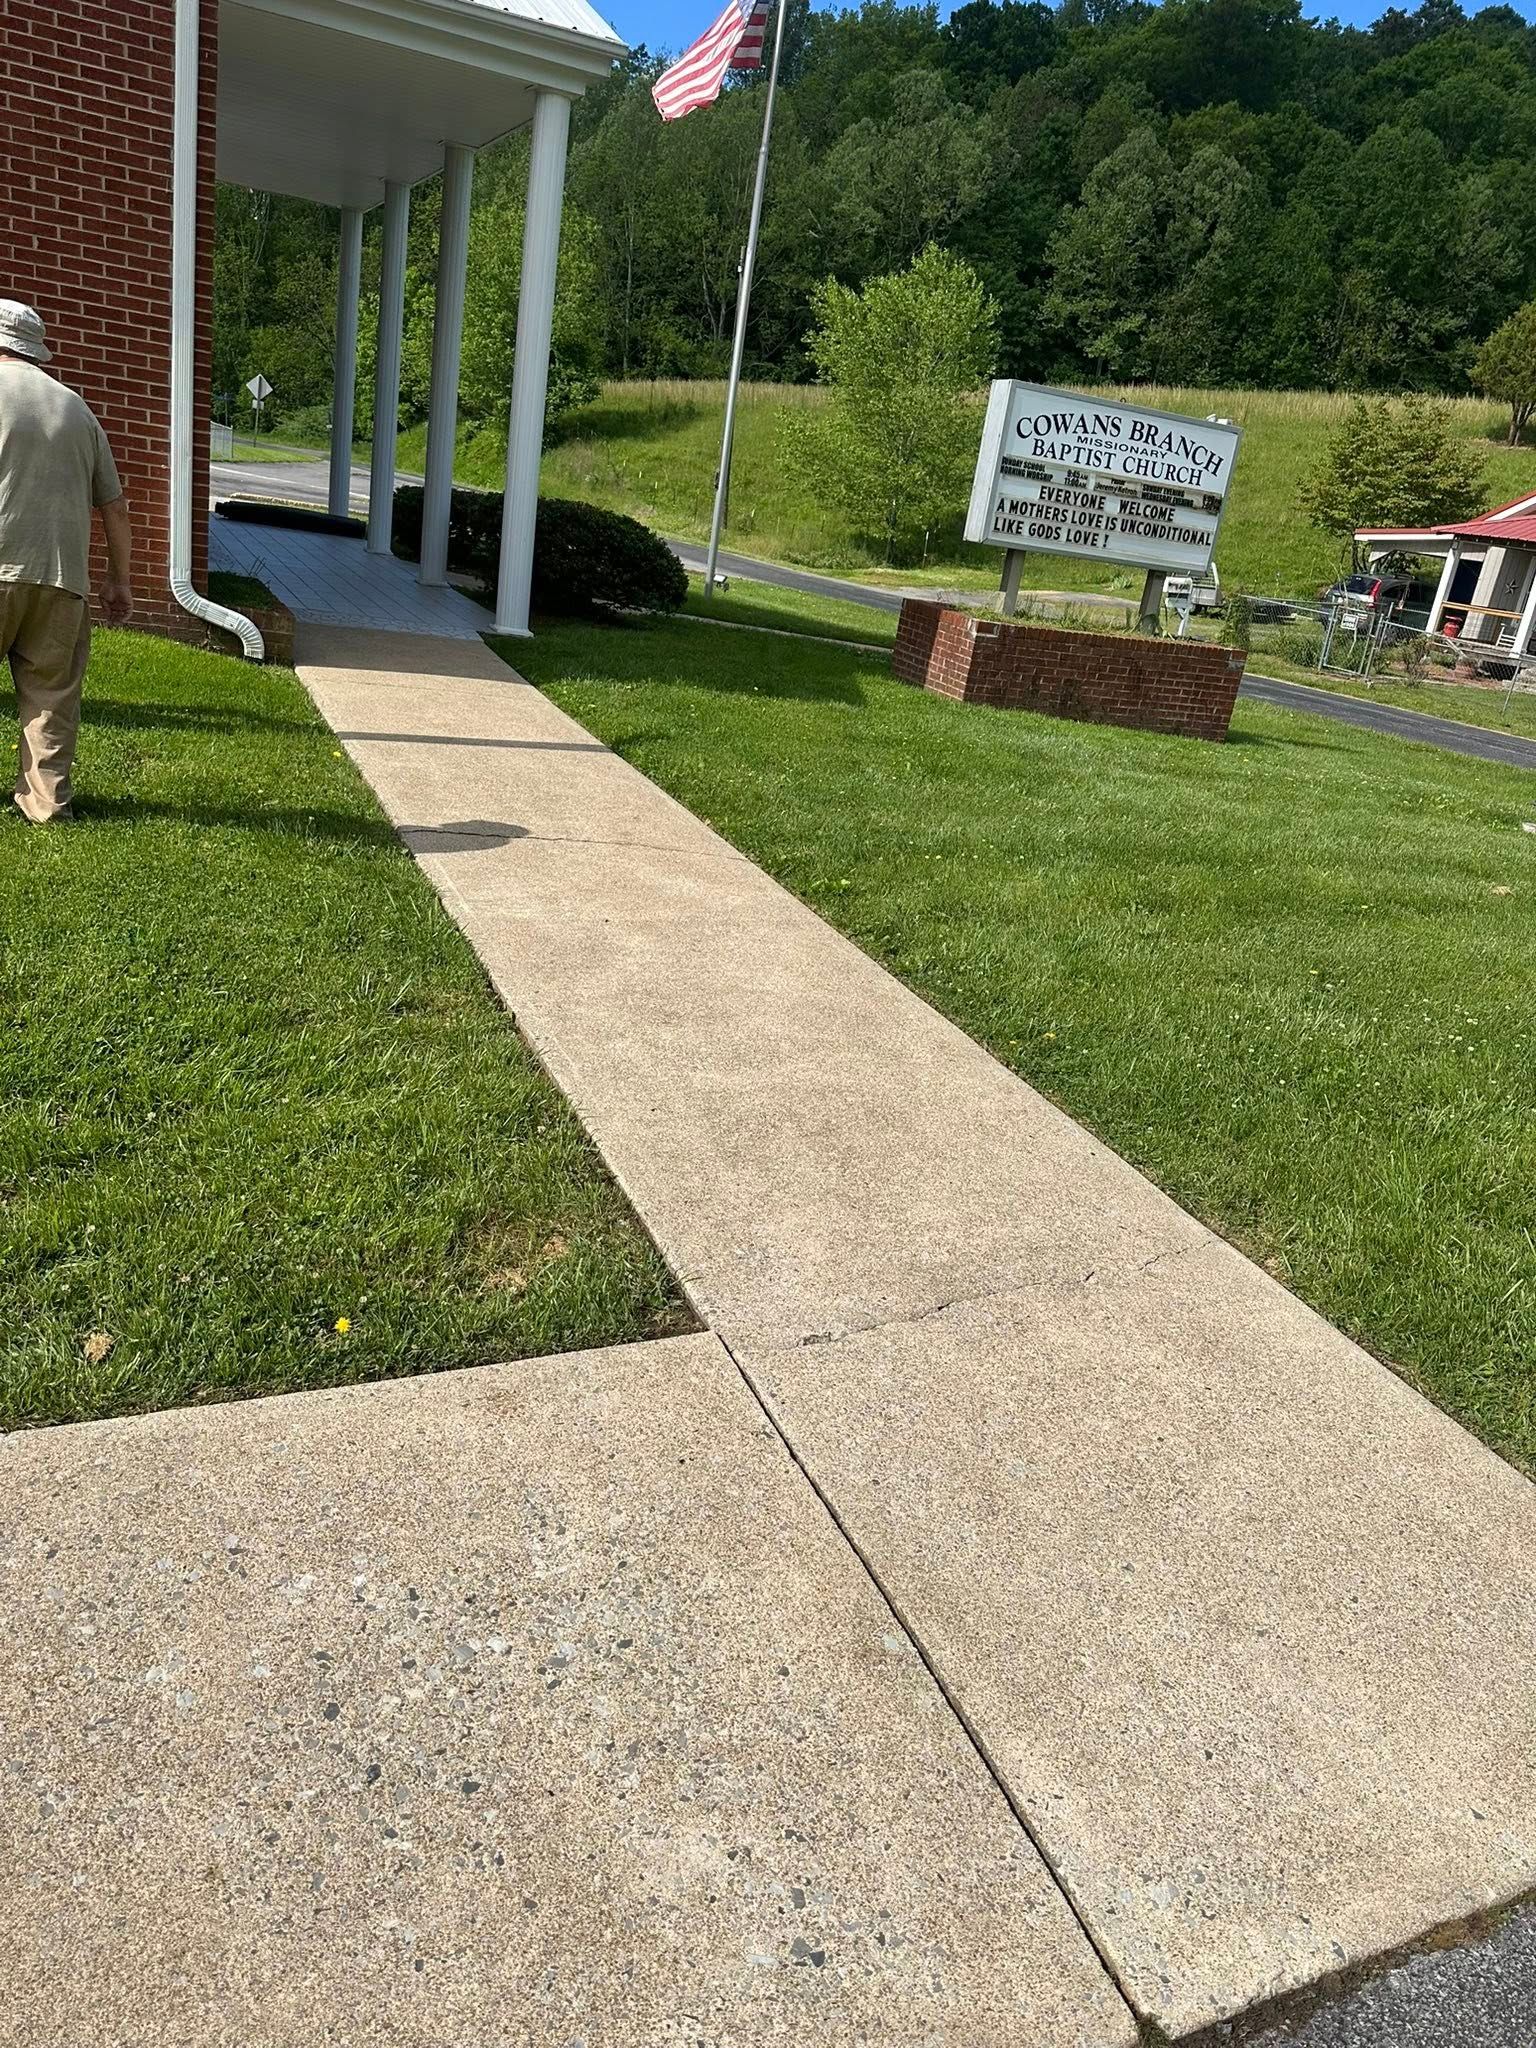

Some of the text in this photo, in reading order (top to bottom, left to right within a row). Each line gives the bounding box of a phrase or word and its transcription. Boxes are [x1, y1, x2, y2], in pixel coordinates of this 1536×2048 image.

[1016, 413, 1224, 477] COWANS BRANCH
[1077, 436, 1167, 459] MISSIONARY
[1000, 465, 1026, 477] MORNING
[1026, 470, 1054, 482] WORSHIP
[1001, 456, 1023, 467] SUNDAY
[1023, 461, 1046, 472] SCHOOL
[1032, 438, 1203, 486] BAPTIST CHURCH
[1096, 482, 1117, 494] Jeremy
[1039, 485, 1106, 510] EVERYONE
[1119, 500, 1176, 522] WELCOME
[993, 517, 1024, 534] LIKE
[1028, 522, 1061, 540] GODS
[997, 498, 1211, 545] A MOTHERS LOVE IS UNCONDITIONAL
